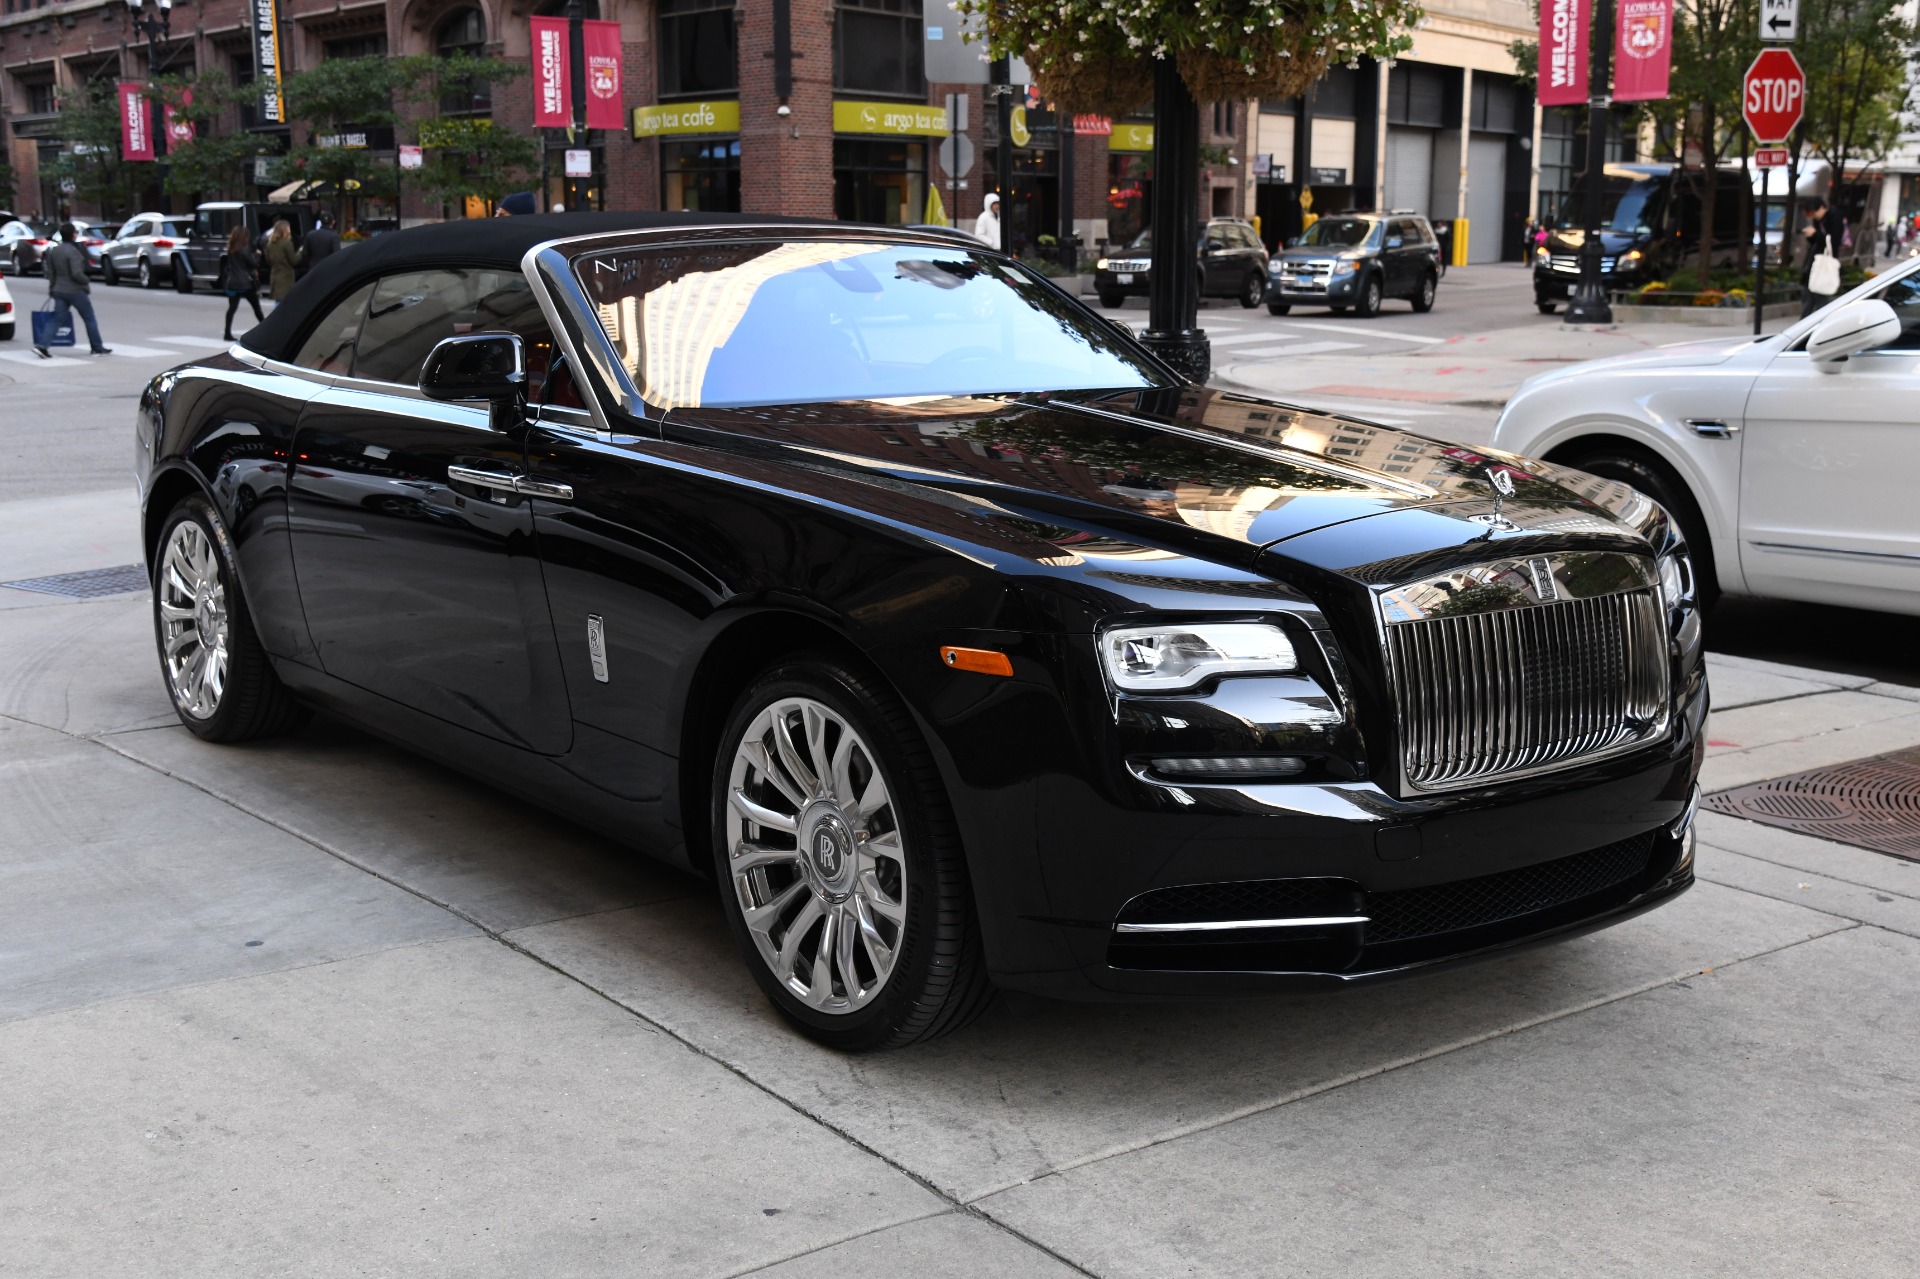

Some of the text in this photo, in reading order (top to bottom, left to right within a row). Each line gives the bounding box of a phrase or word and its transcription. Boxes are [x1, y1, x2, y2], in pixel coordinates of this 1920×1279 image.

[257, 0, 273, 31] BAGE
[1624, 1, 1667, 13] LOYOLA
[1551, 0, 1569, 88] WELCOM
[1568, 20, 1577, 54] TOWER
[541, 30, 555, 113] WELCOME
[1567, 55, 1576, 87] WATER
[262, 67, 279, 120] EINSN
[1747, 78, 1801, 114] STOP
[126, 92, 141, 151] WELCOME
[662, 112, 679, 128] tea
[682, 103, 715, 127] café
[884, 110, 948, 133] argo tea caf
[1758, 152, 1785, 164] ALL WAY
[820, 834, 836, 871] RR
